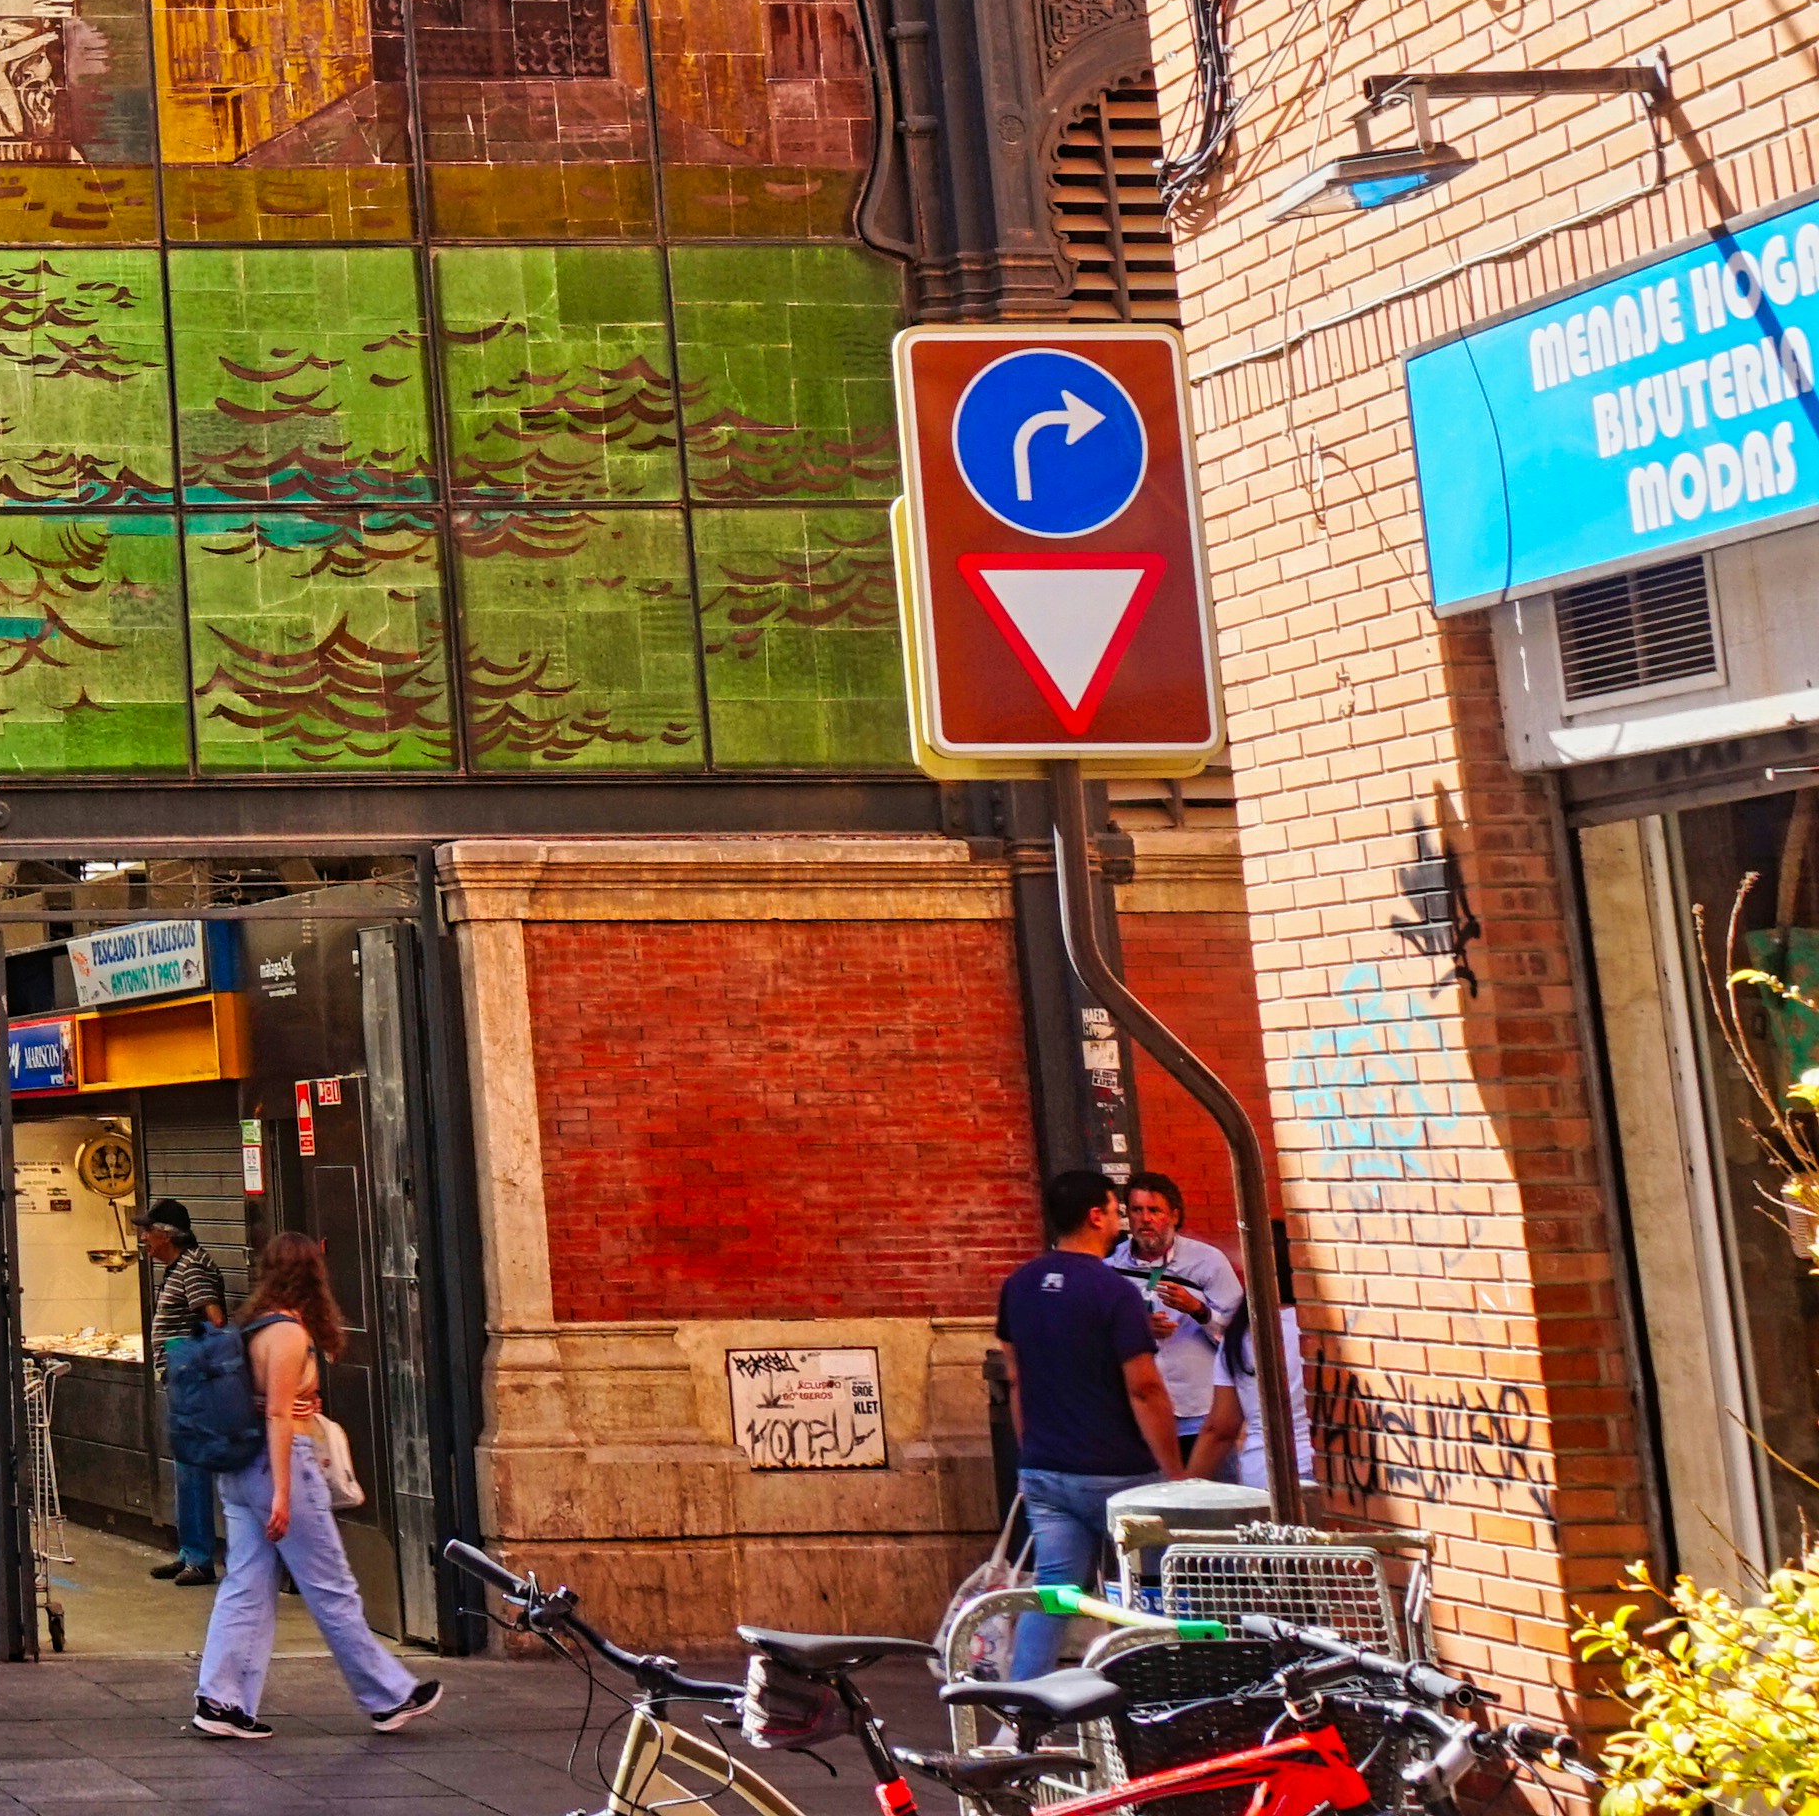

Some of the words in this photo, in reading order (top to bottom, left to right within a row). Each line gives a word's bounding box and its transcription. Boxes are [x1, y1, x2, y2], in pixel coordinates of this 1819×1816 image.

[1530, 277, 1685, 393] MENAJE
[1592, 326, 1814, 459] BISUTERIA
[1627, 421, 1798, 534] MODAS
[91, 933, 137, 967] PESCADOS
[138, 931, 145, 957] Y
[146, 921, 196, 957] MARISCOS
[157, 960, 182, 988] PACO
